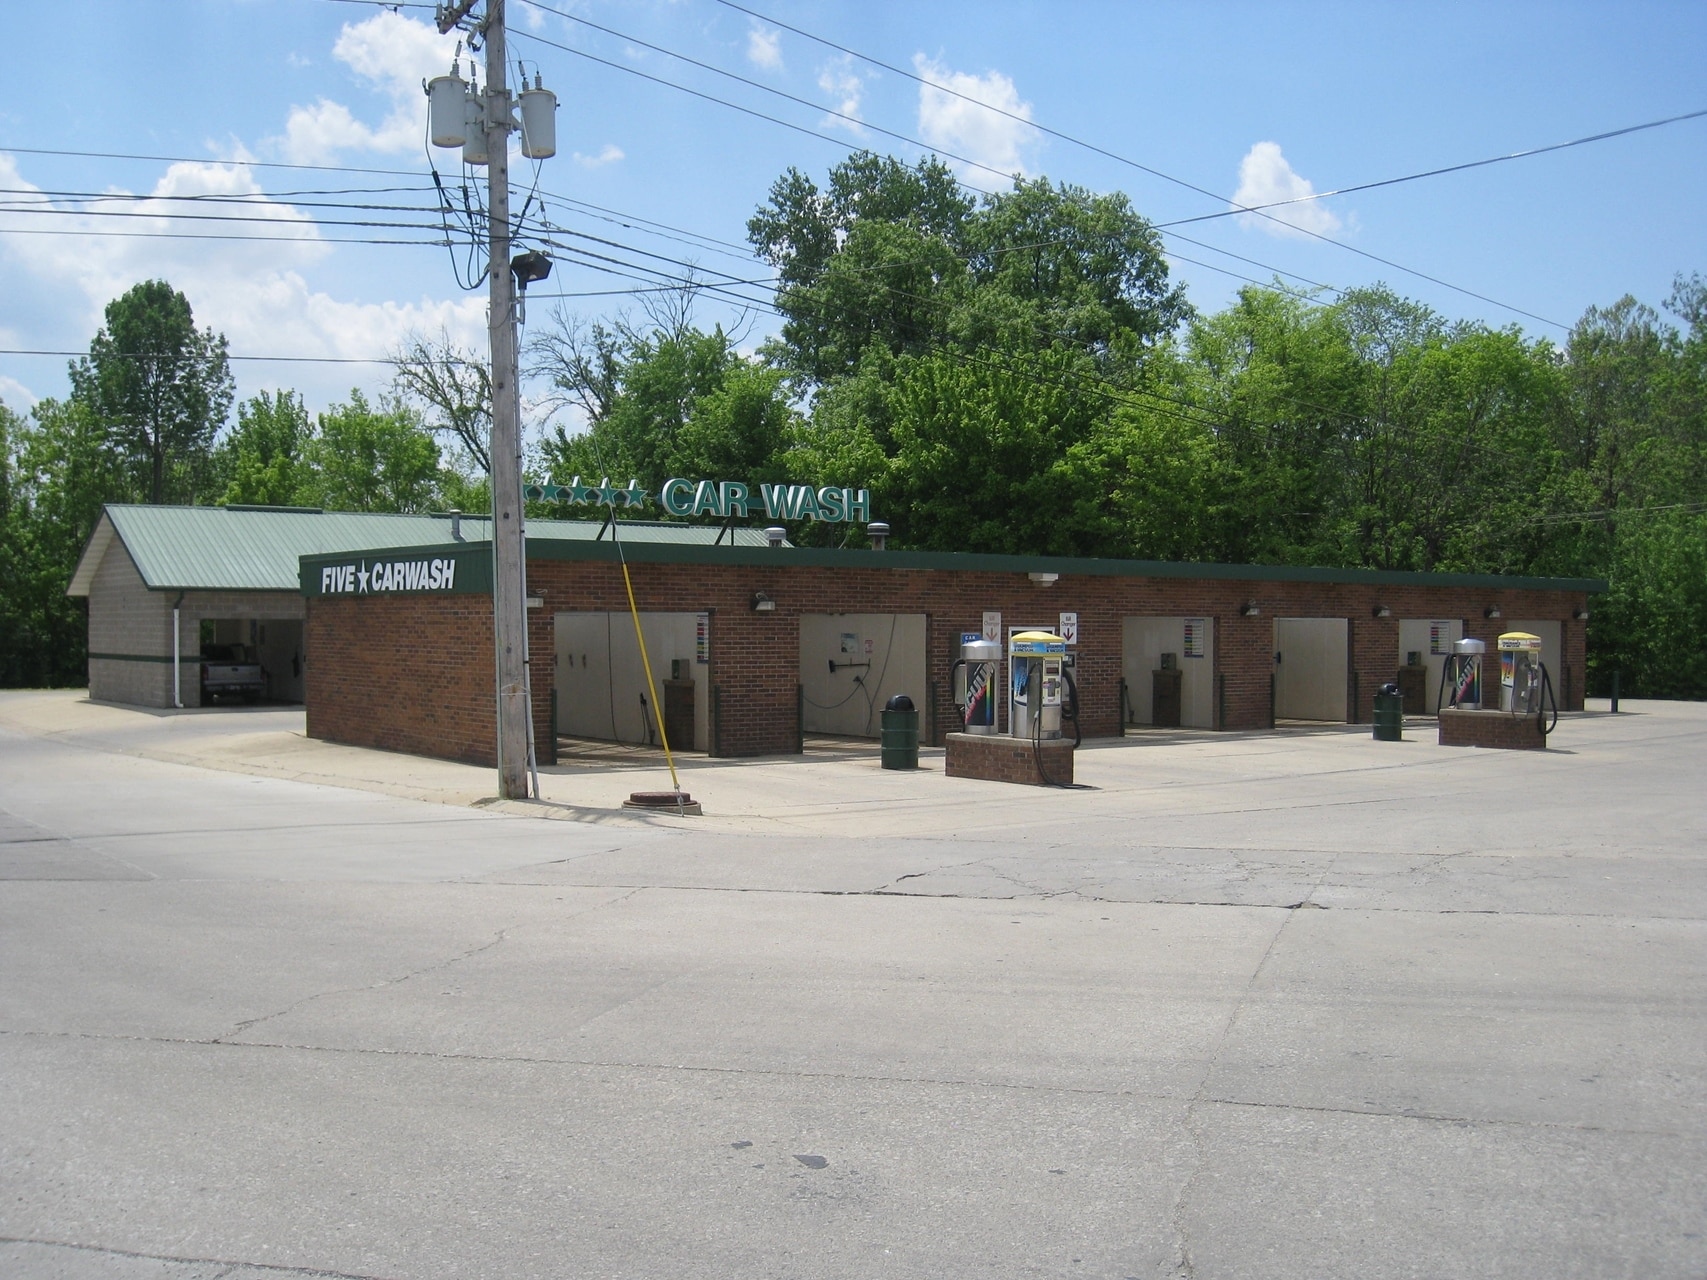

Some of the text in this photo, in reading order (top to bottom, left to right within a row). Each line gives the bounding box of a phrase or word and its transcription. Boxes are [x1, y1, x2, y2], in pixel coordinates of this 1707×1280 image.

[662, 478, 869, 523] CAR WASH
[321, 559, 456, 593] FIVE CARWASH
